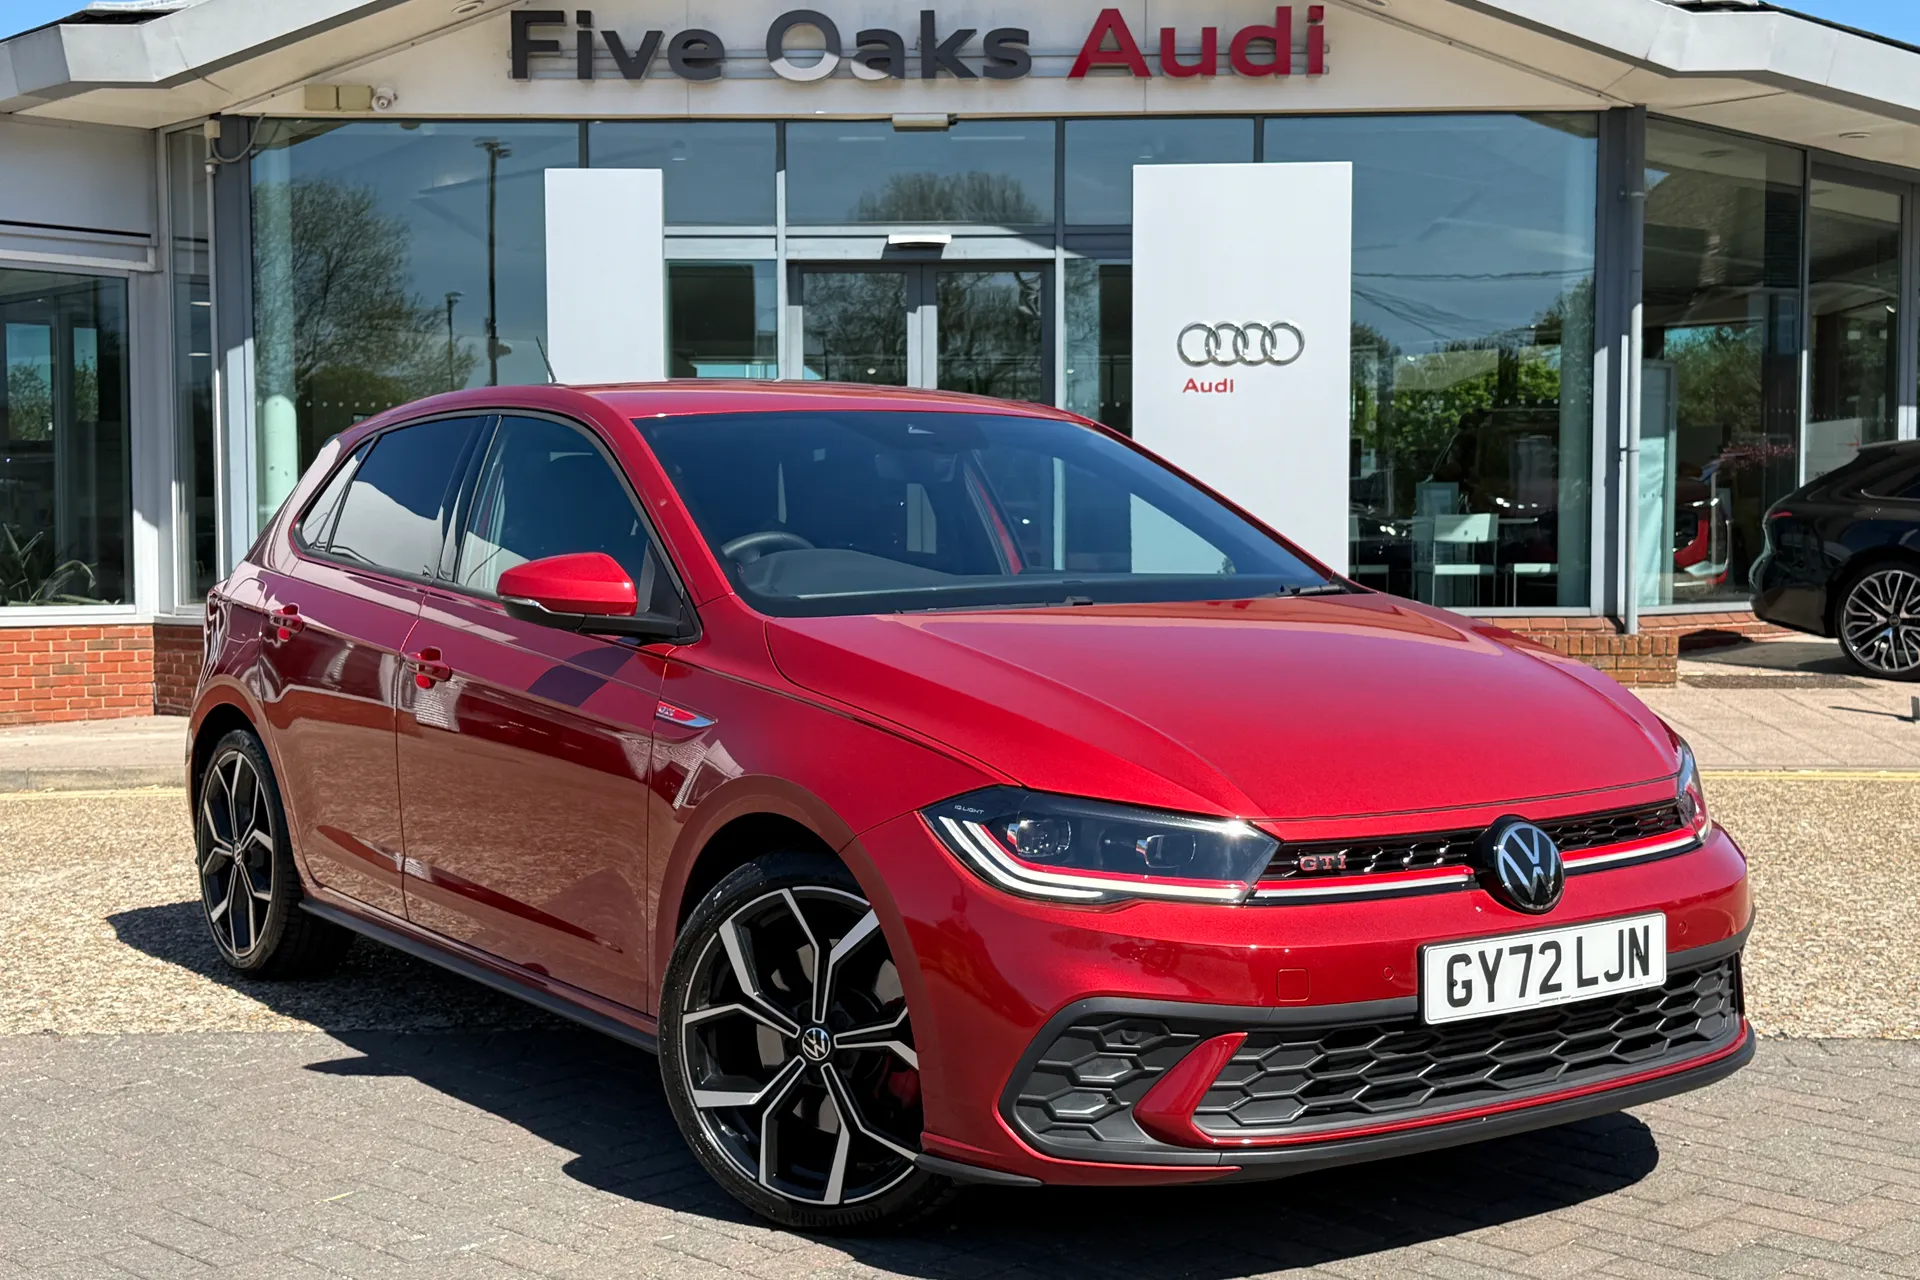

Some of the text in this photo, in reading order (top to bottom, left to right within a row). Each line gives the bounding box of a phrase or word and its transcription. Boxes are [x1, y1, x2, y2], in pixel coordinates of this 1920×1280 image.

[510, 5, 1325, 82] Five Oaks Audi
[1182, 377, 1235, 394] Audi
[1299, 854, 1347, 871] GTI
[1446, 924, 1650, 1008] GY72 LJN
